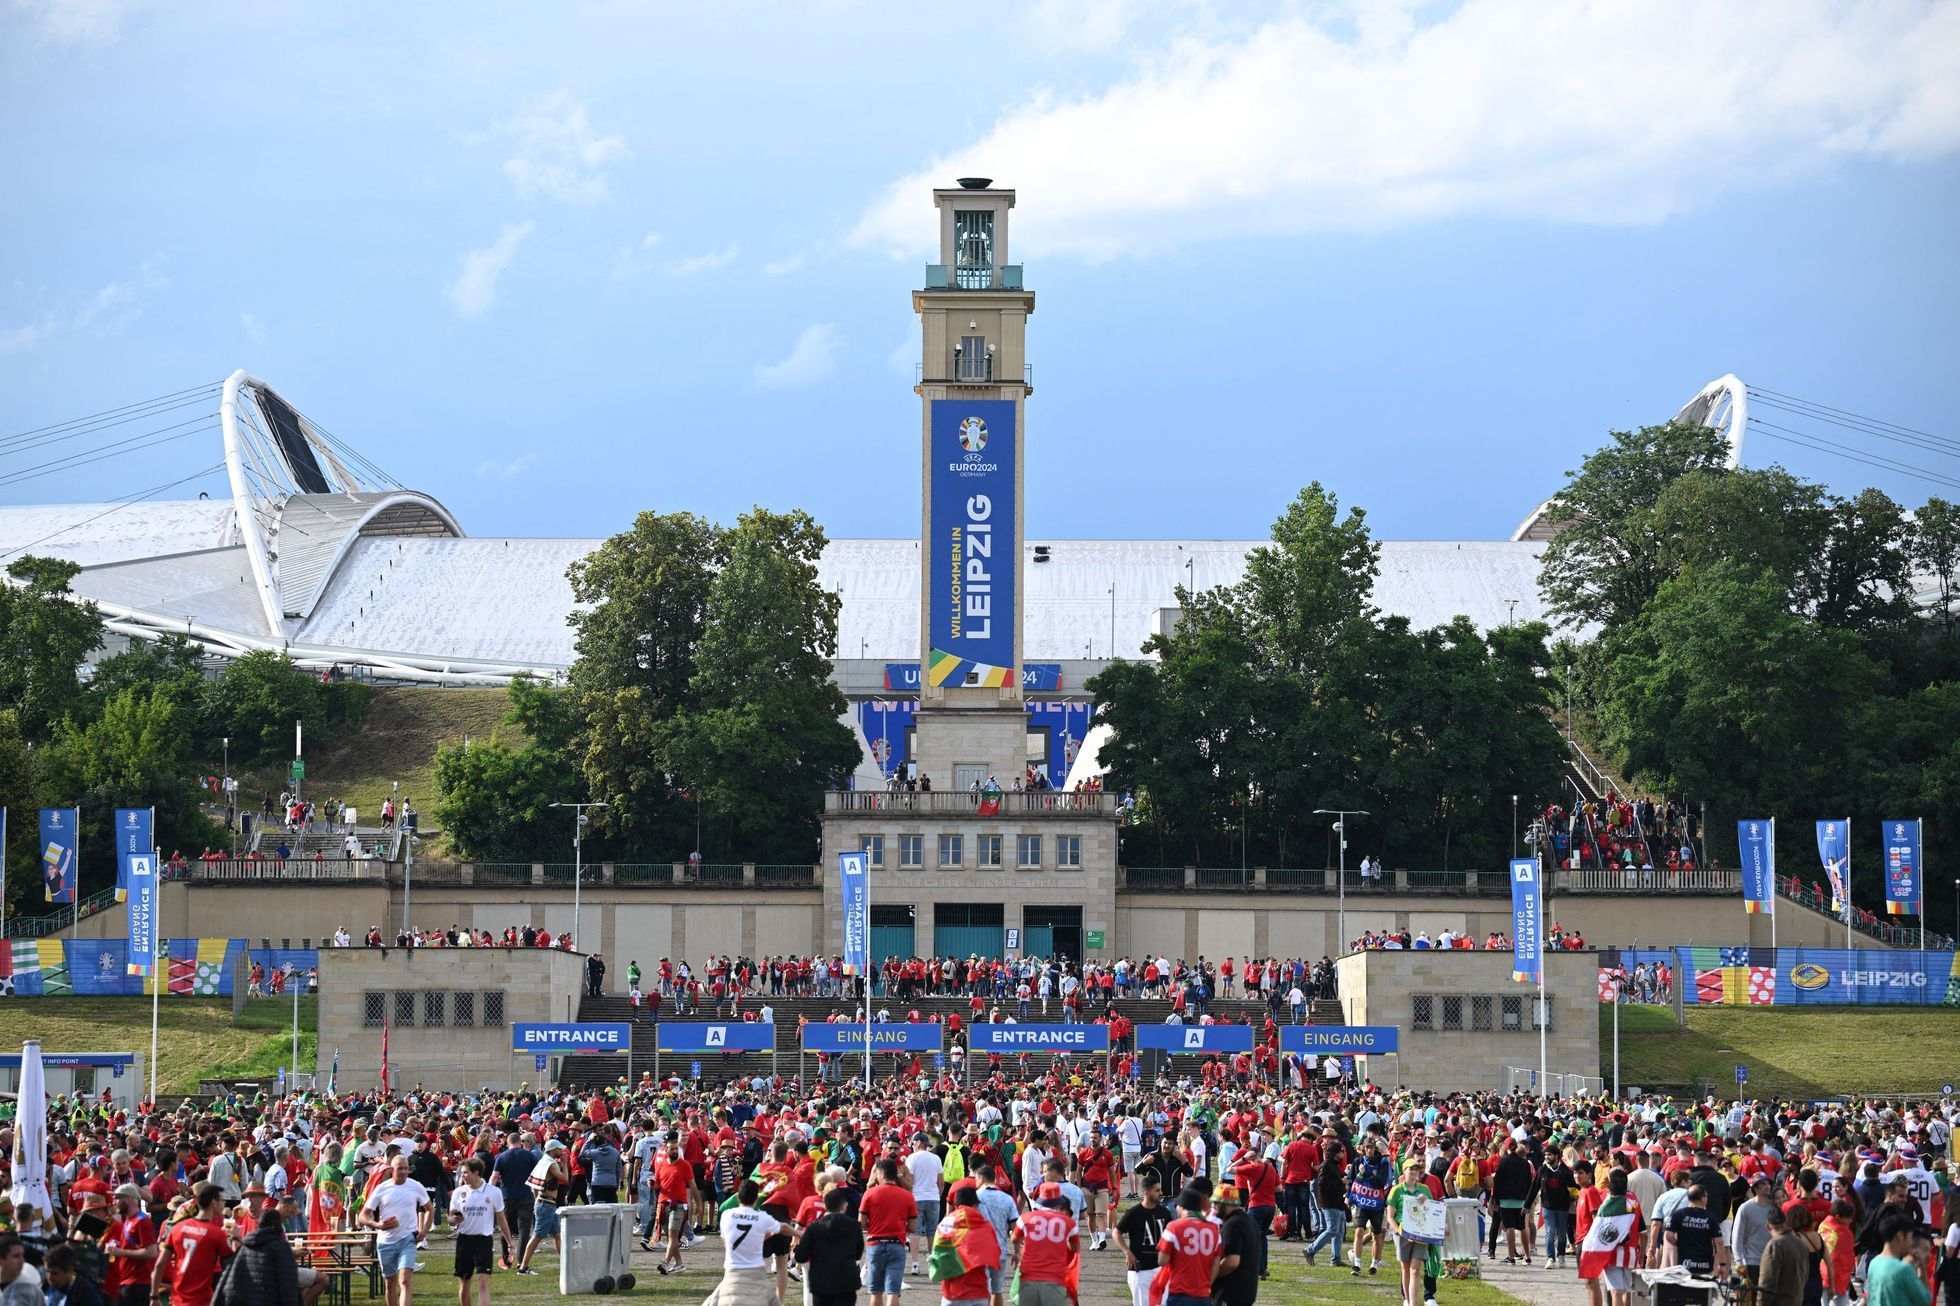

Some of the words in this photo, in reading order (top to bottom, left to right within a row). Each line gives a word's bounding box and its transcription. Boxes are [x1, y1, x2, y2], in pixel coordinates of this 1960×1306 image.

[964, 453, 983, 463] UEFA
[950, 463, 997, 471] EURO2024
[953, 527, 961, 539] IN
[966, 494, 992, 639] LEIPZIG
[952, 543, 961, 639] WILLKOMMEN
[137, 861, 145, 871] A
[848, 861, 857, 871] A
[1519, 868, 1528, 878] A
[1841, 970, 1927, 987] LEIPZIG
[525, 1030, 618, 1042] ENTRANCE
[711, 1030, 721, 1042] A
[837, 1031, 907, 1043] EINGANG
[992, 1031, 1084, 1043] ENTRANCE
[1189, 1033, 1200, 1044] A
[1304, 1033, 1375, 1045] EINGANG
[1908, 1180, 1929, 1200] 20
[1029, 1215, 1066, 1243] 30
[732, 1223, 752, 1251] 7
[1183, 1227, 1214, 1256] 30
[180, 1238, 197, 1273] 7
